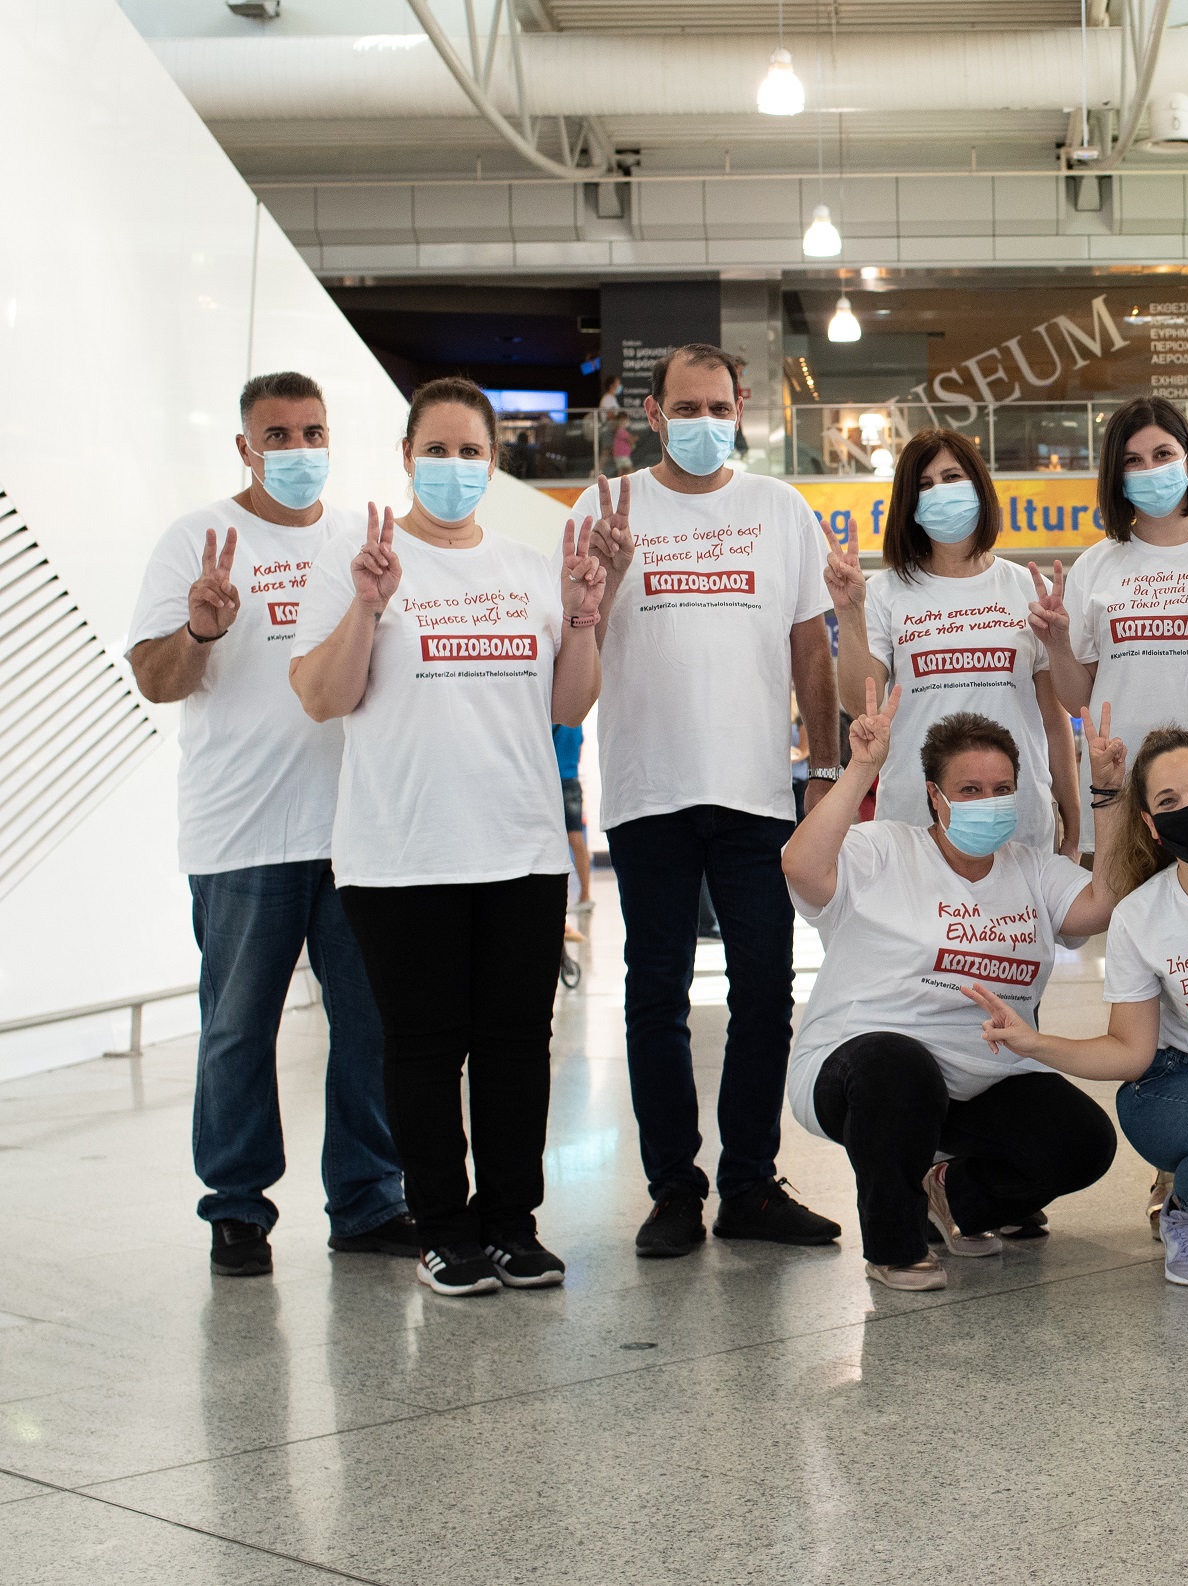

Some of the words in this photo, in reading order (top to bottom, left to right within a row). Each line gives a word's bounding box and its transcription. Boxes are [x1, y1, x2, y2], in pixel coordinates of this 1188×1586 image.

[634, 533, 670, 548] Ζήστε
[673, 534, 688, 544] το
[693, 524, 733, 542] όνειρό
[737, 523, 762, 538] σας!
[642, 550, 692, 567] Είμαστε
[696, 542, 724, 564] μαζί
[729, 541, 754, 556] σας!
[253, 560, 291, 576] Καλή
[251, 581, 286, 594] είστε
[649, 574, 749, 591] ΚΩΤΣΟΒΟΛΟΣ
[1134, 570, 1174, 587] καρδιά
[1133, 584, 1148, 596] θα
[1152, 583, 1186, 599] χτυπά
[402, 598, 441, 612] Ζήστε
[445, 599, 459, 607] το
[464, 590, 505, 605] όνειρό
[1106, 602, 1126, 613] στο
[1130, 599, 1160, 610] Τόκιο
[1163, 595, 1188, 610] μαζί
[416, 615, 468, 630] Είμαστε
[472, 606, 501, 626] μαζί
[903, 610, 942, 626] Καλή
[898, 629, 932, 645] είστε
[936, 621, 963, 635] ήδη
[427, 638, 532, 657] ΚΩΤΣΟΒΟΛΟΣ
[917, 651, 1012, 673] ΚΩΤΣΟΒΟΛΟΣ
[938, 902, 981, 919] Καλή
[946, 922, 1006, 944] Ελλάδα
[1009, 925, 1037, 952] μας!
[940, 953, 1035, 982] ΚΩΤΣΟΒΟΛΟΣ
